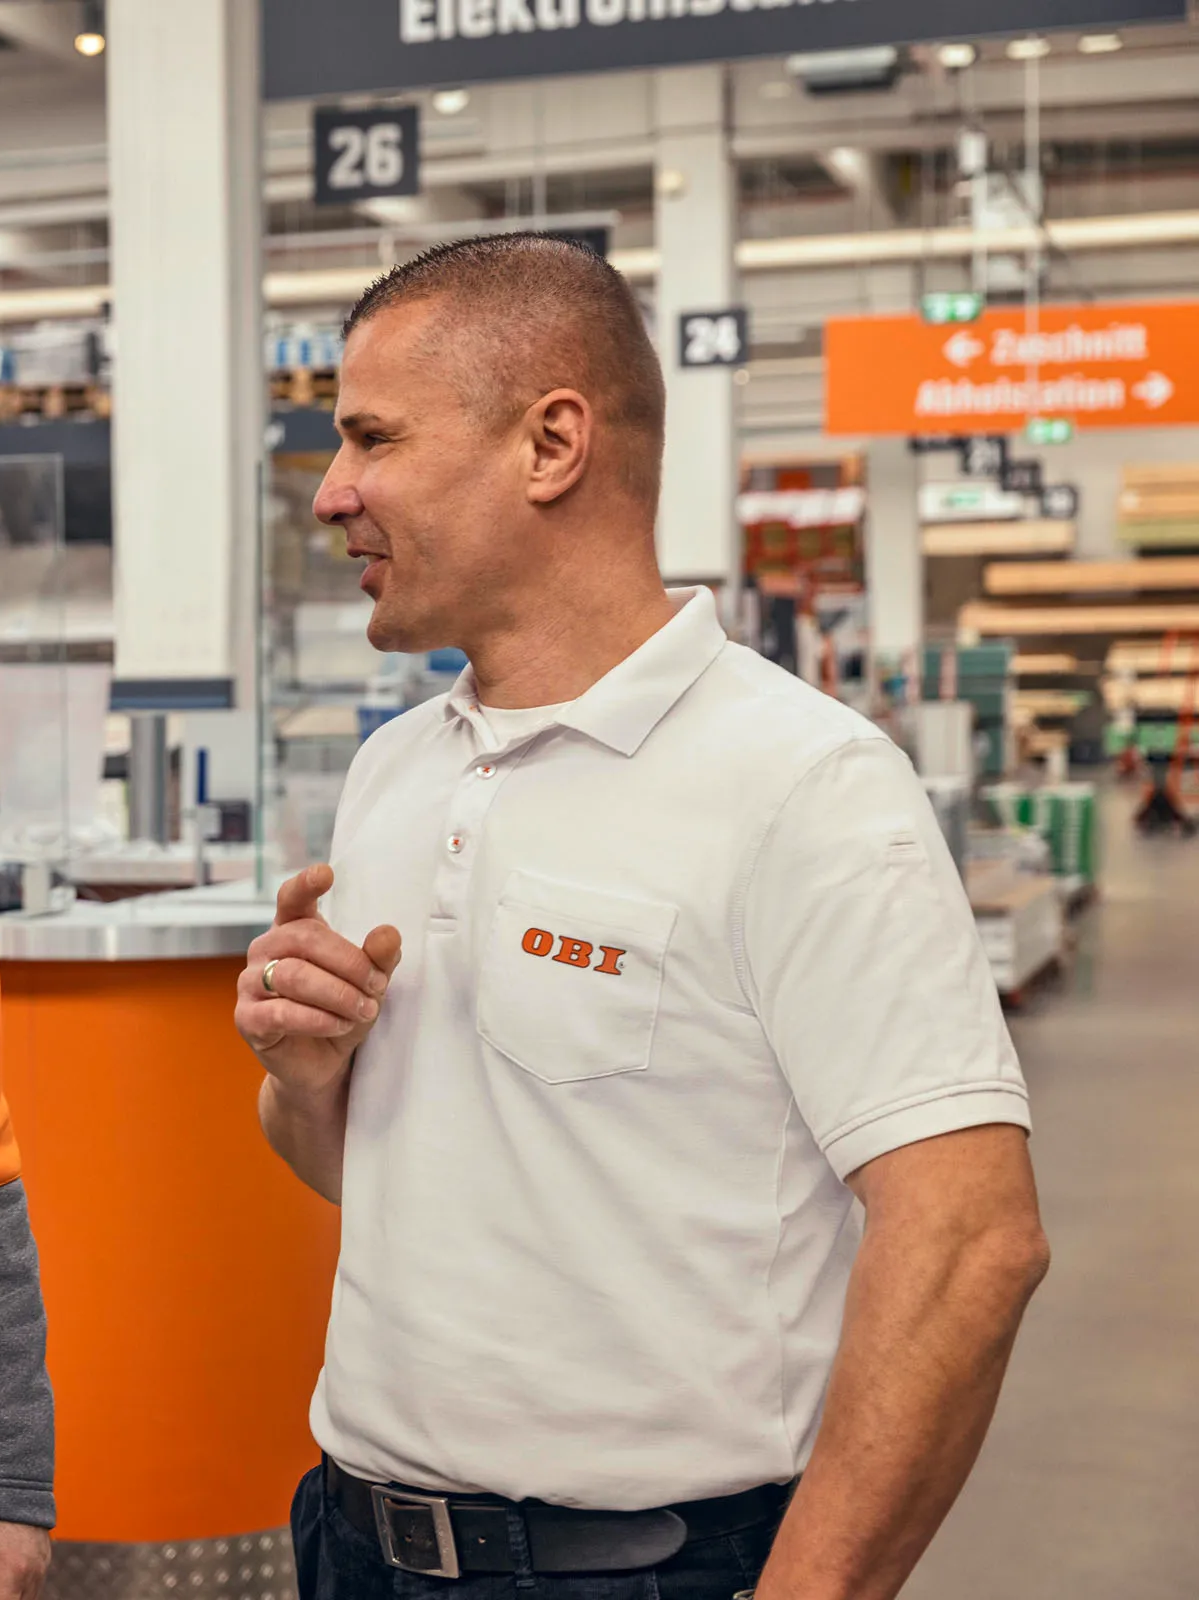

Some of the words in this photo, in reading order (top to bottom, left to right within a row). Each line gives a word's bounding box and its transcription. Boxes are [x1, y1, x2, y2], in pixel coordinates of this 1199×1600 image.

[328, 122, 404, 190] 26
[685, 316, 741, 363] 24
[521, 927, 627, 976] OBI
